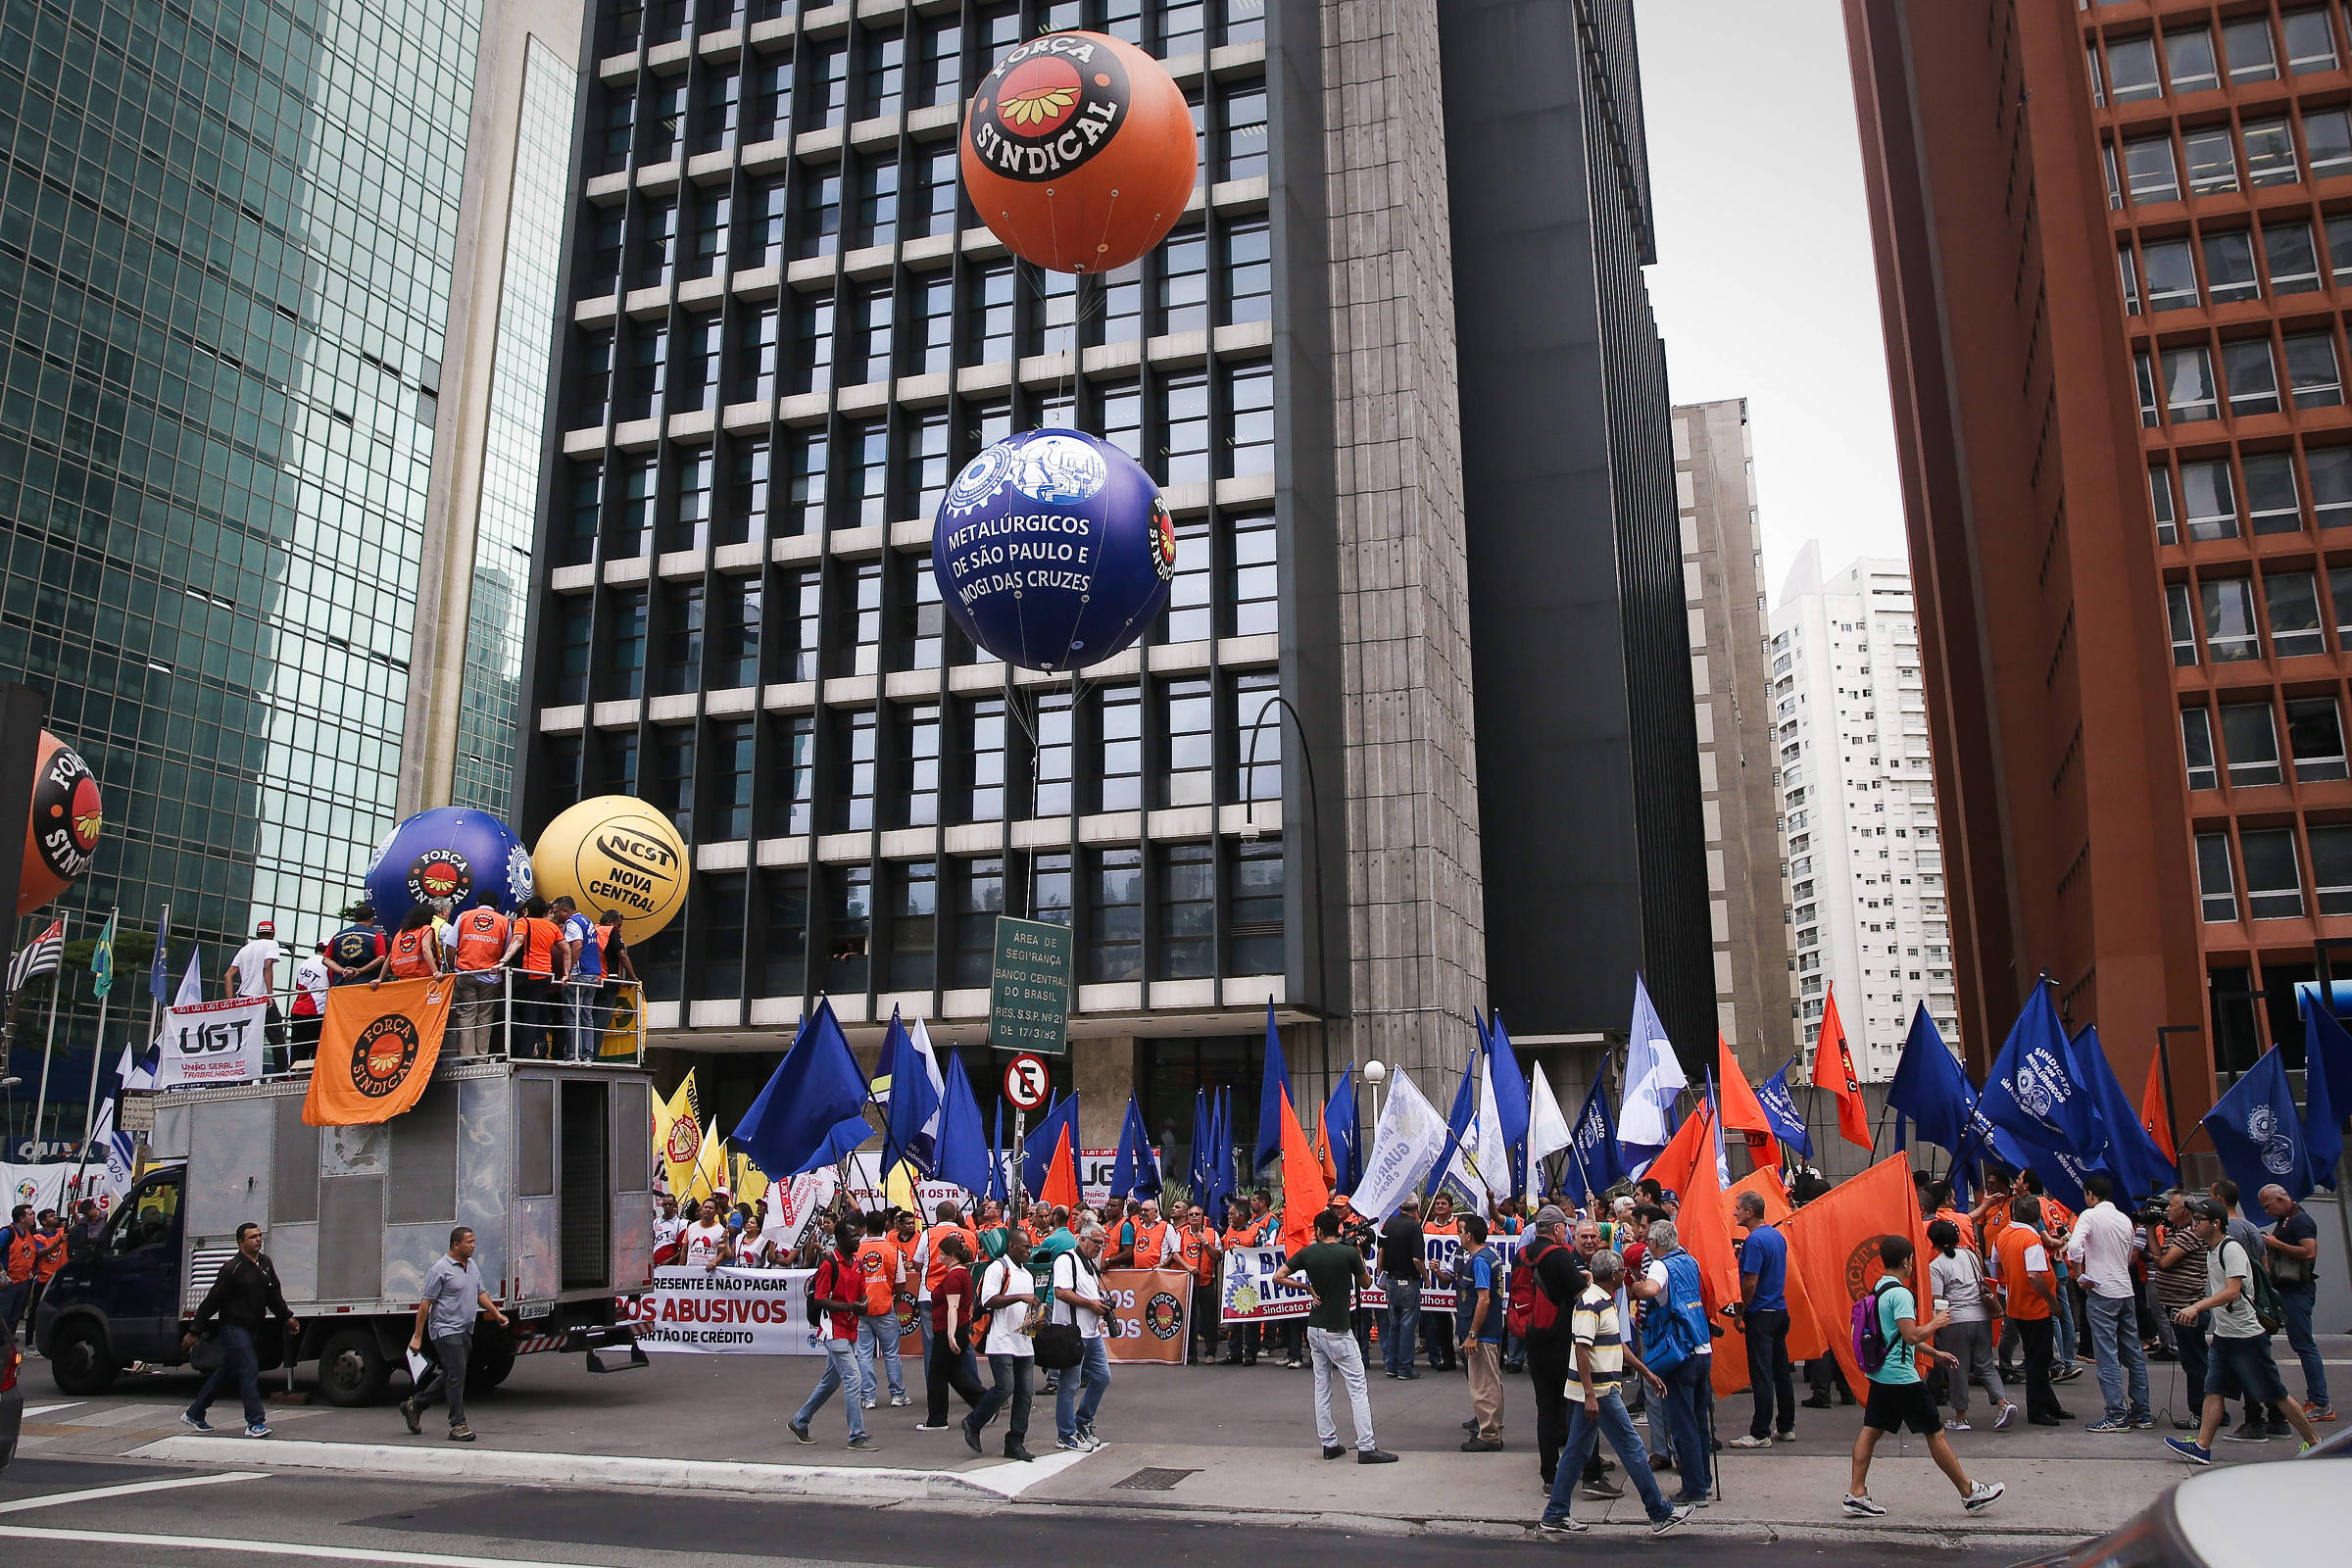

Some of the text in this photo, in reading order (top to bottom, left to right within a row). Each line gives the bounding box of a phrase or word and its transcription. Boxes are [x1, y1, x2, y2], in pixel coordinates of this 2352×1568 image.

[991, 36, 1096, 79] FORÇA
[977, 101, 1117, 174] SINDICAL
[948, 513, 1090, 552] METALÚRGICOS
[953, 542, 1089, 578] DE SÃO PAULO E
[958, 569, 1091, 606] MOGI DAS CRUZES
[420, 850, 468, 872] FORÇA
[610, 836, 670, 866] NCST
[409, 879, 469, 905] SINAL
[610, 867, 652, 894] NOVA
[589, 880, 655, 912] CENTRAL
[1013, 930, 1057, 948] ÁREA DE
[300, 967, 321, 983] UGT
[995, 968, 1067, 987] BANCO CENTRAL
[1004, 987, 1056, 1002] DO BRASIL
[996, 1006, 1016, 1019] RES.
[179, 1019, 253, 1054] UGT
[364, 1018, 412, 1044] FORÇA
[1001, 1025, 1013, 1036] DE
[209, 1061, 233, 1070] GERAL
[354, 1058, 414, 1095] SINDICAL
[2025, 1053, 2066, 1103] METALÚRGICOS
[2034, 1047, 2072, 1096] SINDICATO
[2044, 1065, 2056, 1078] DOS
[706, 1276, 713, 1290] É
[716, 1276, 742, 1291] NÃO
[745, 1278, 787, 1292] PAGAR
[662, 1298, 787, 1324] ABUSIVOS
[1152, 1295, 1176, 1308] FORÇA
[1262, 1303, 1303, 1315] Sindicato
[682, 1331, 698, 1343] DE
[701, 1329, 754, 1344] CRÉDITO
